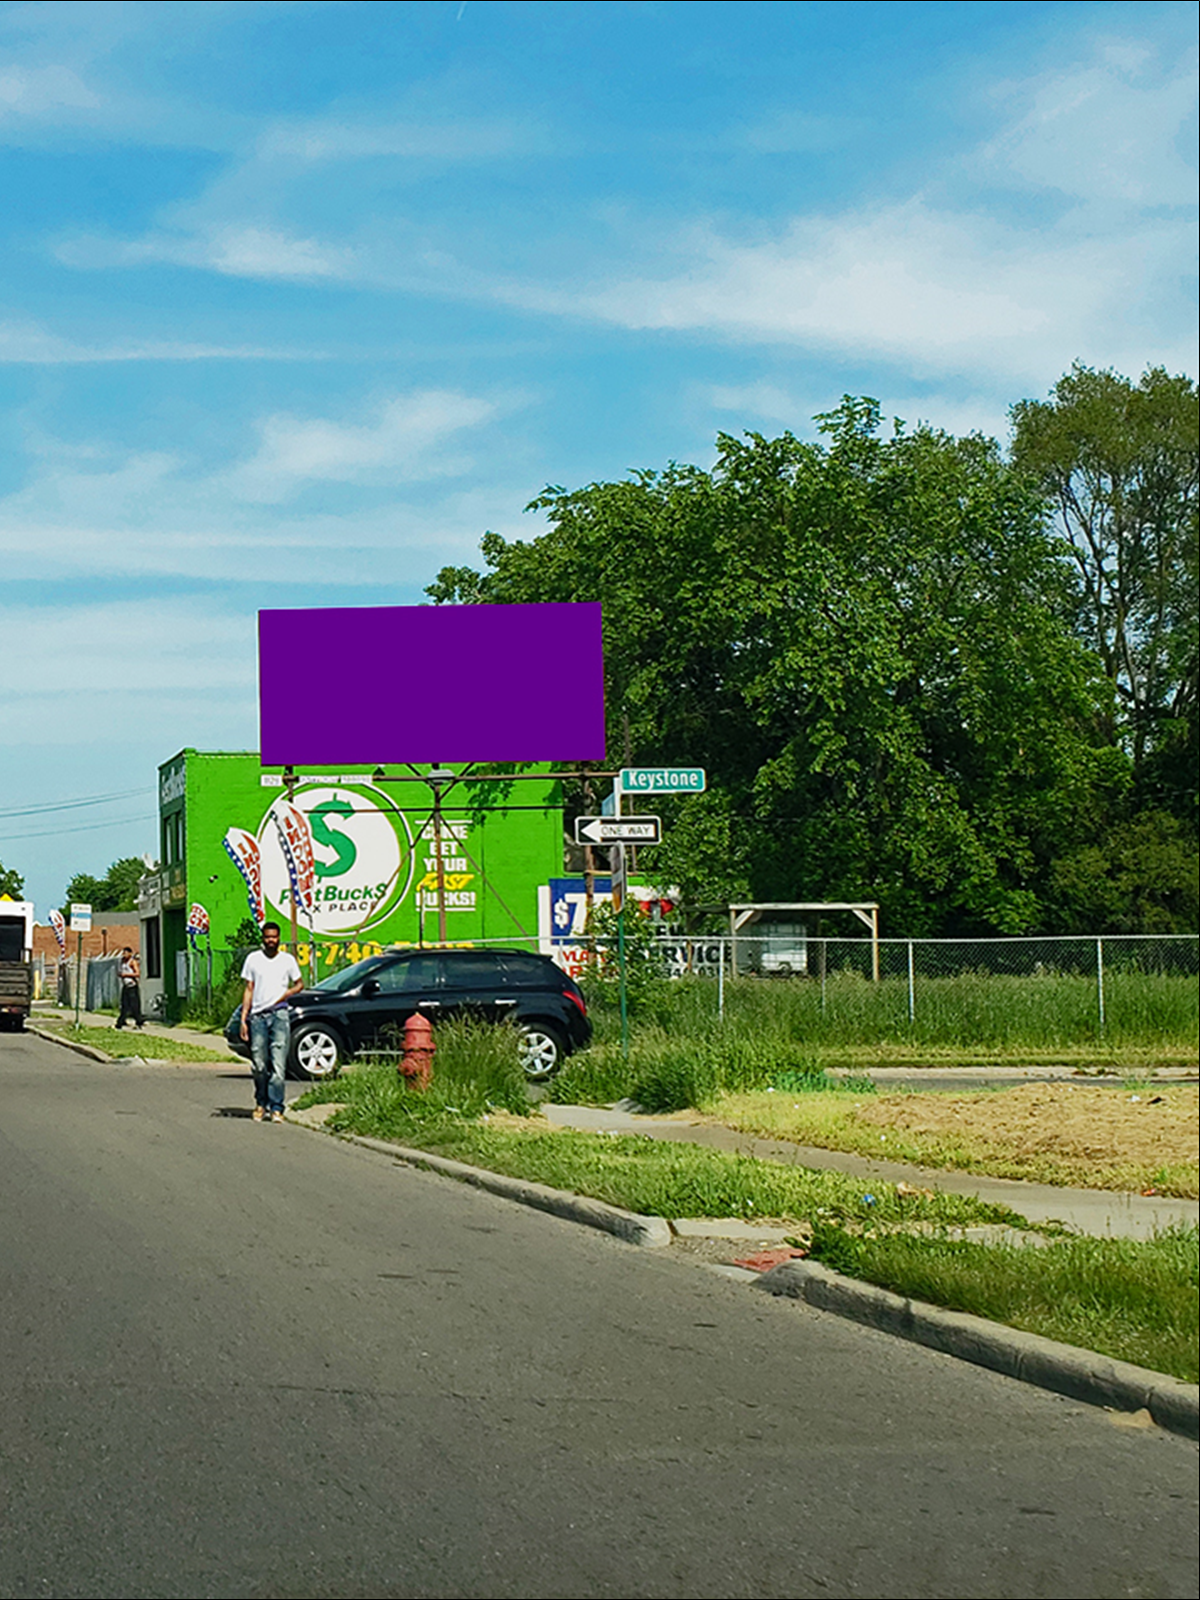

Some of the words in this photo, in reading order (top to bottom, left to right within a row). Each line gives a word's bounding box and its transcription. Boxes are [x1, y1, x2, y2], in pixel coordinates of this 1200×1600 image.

[629, 770, 699, 791] Keystone
[601, 826, 623, 836] ONE
[628, 826, 650, 836] WAY
[279, 883, 386, 905] FtBuckS
